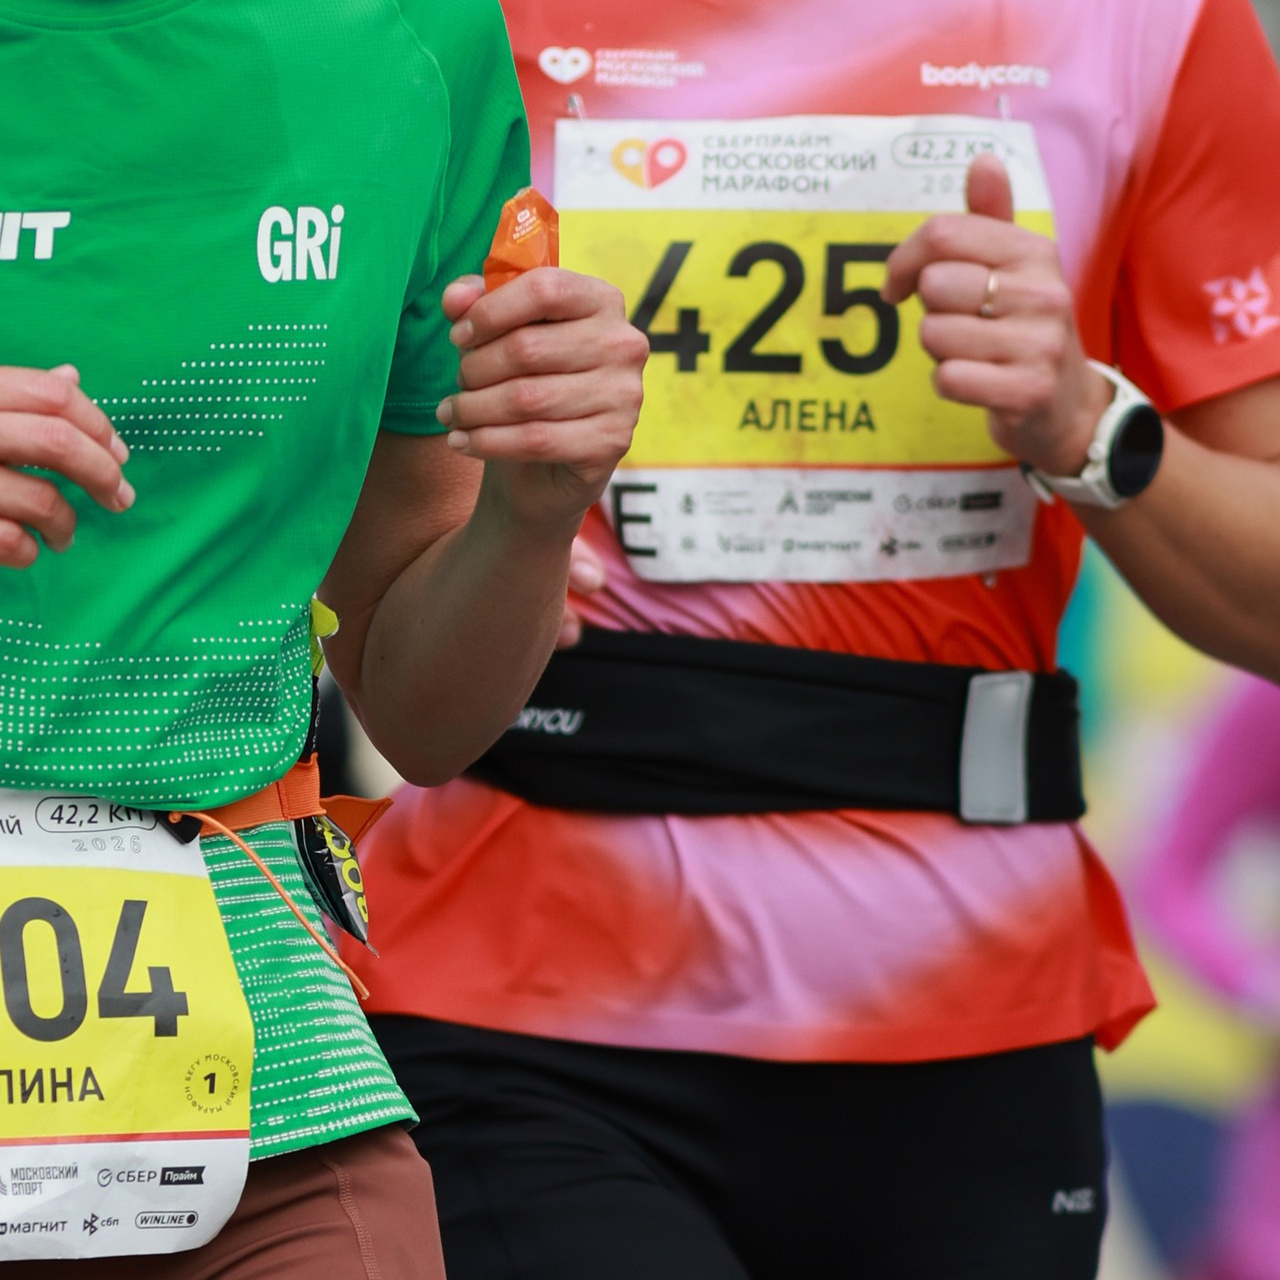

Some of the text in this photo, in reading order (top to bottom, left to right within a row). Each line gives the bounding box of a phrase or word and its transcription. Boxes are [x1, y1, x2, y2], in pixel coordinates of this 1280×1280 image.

[920, 61, 1051, 91] bodycare
[702, 132, 832, 149] СБЕРПРАЙМ
[906, 140, 957, 161] 42,2
[702, 148, 876, 171] МОСКОВСКИЙ
[702, 174, 831, 194] МАРАФОН
[257, 204, 345, 283] GRi
[629, 241, 901, 376] 425
[738, 399, 876, 433] АЛЕНА
[610, 482, 658, 558] E
[50, 803, 99, 827] 42,2
[203, 1072, 217, 1095] 1
[10, 1162, 79, 1181] МОСКОВСКИЙ
[116, 1169, 198, 1183] СБЕР Прайм
[11, 1181, 44, 1196] СПОРТ
[9, 1220, 69, 1235] магнит
[100, 1218, 120, 1227] сбп
[139, 1214, 186, 1226] WINLINE
